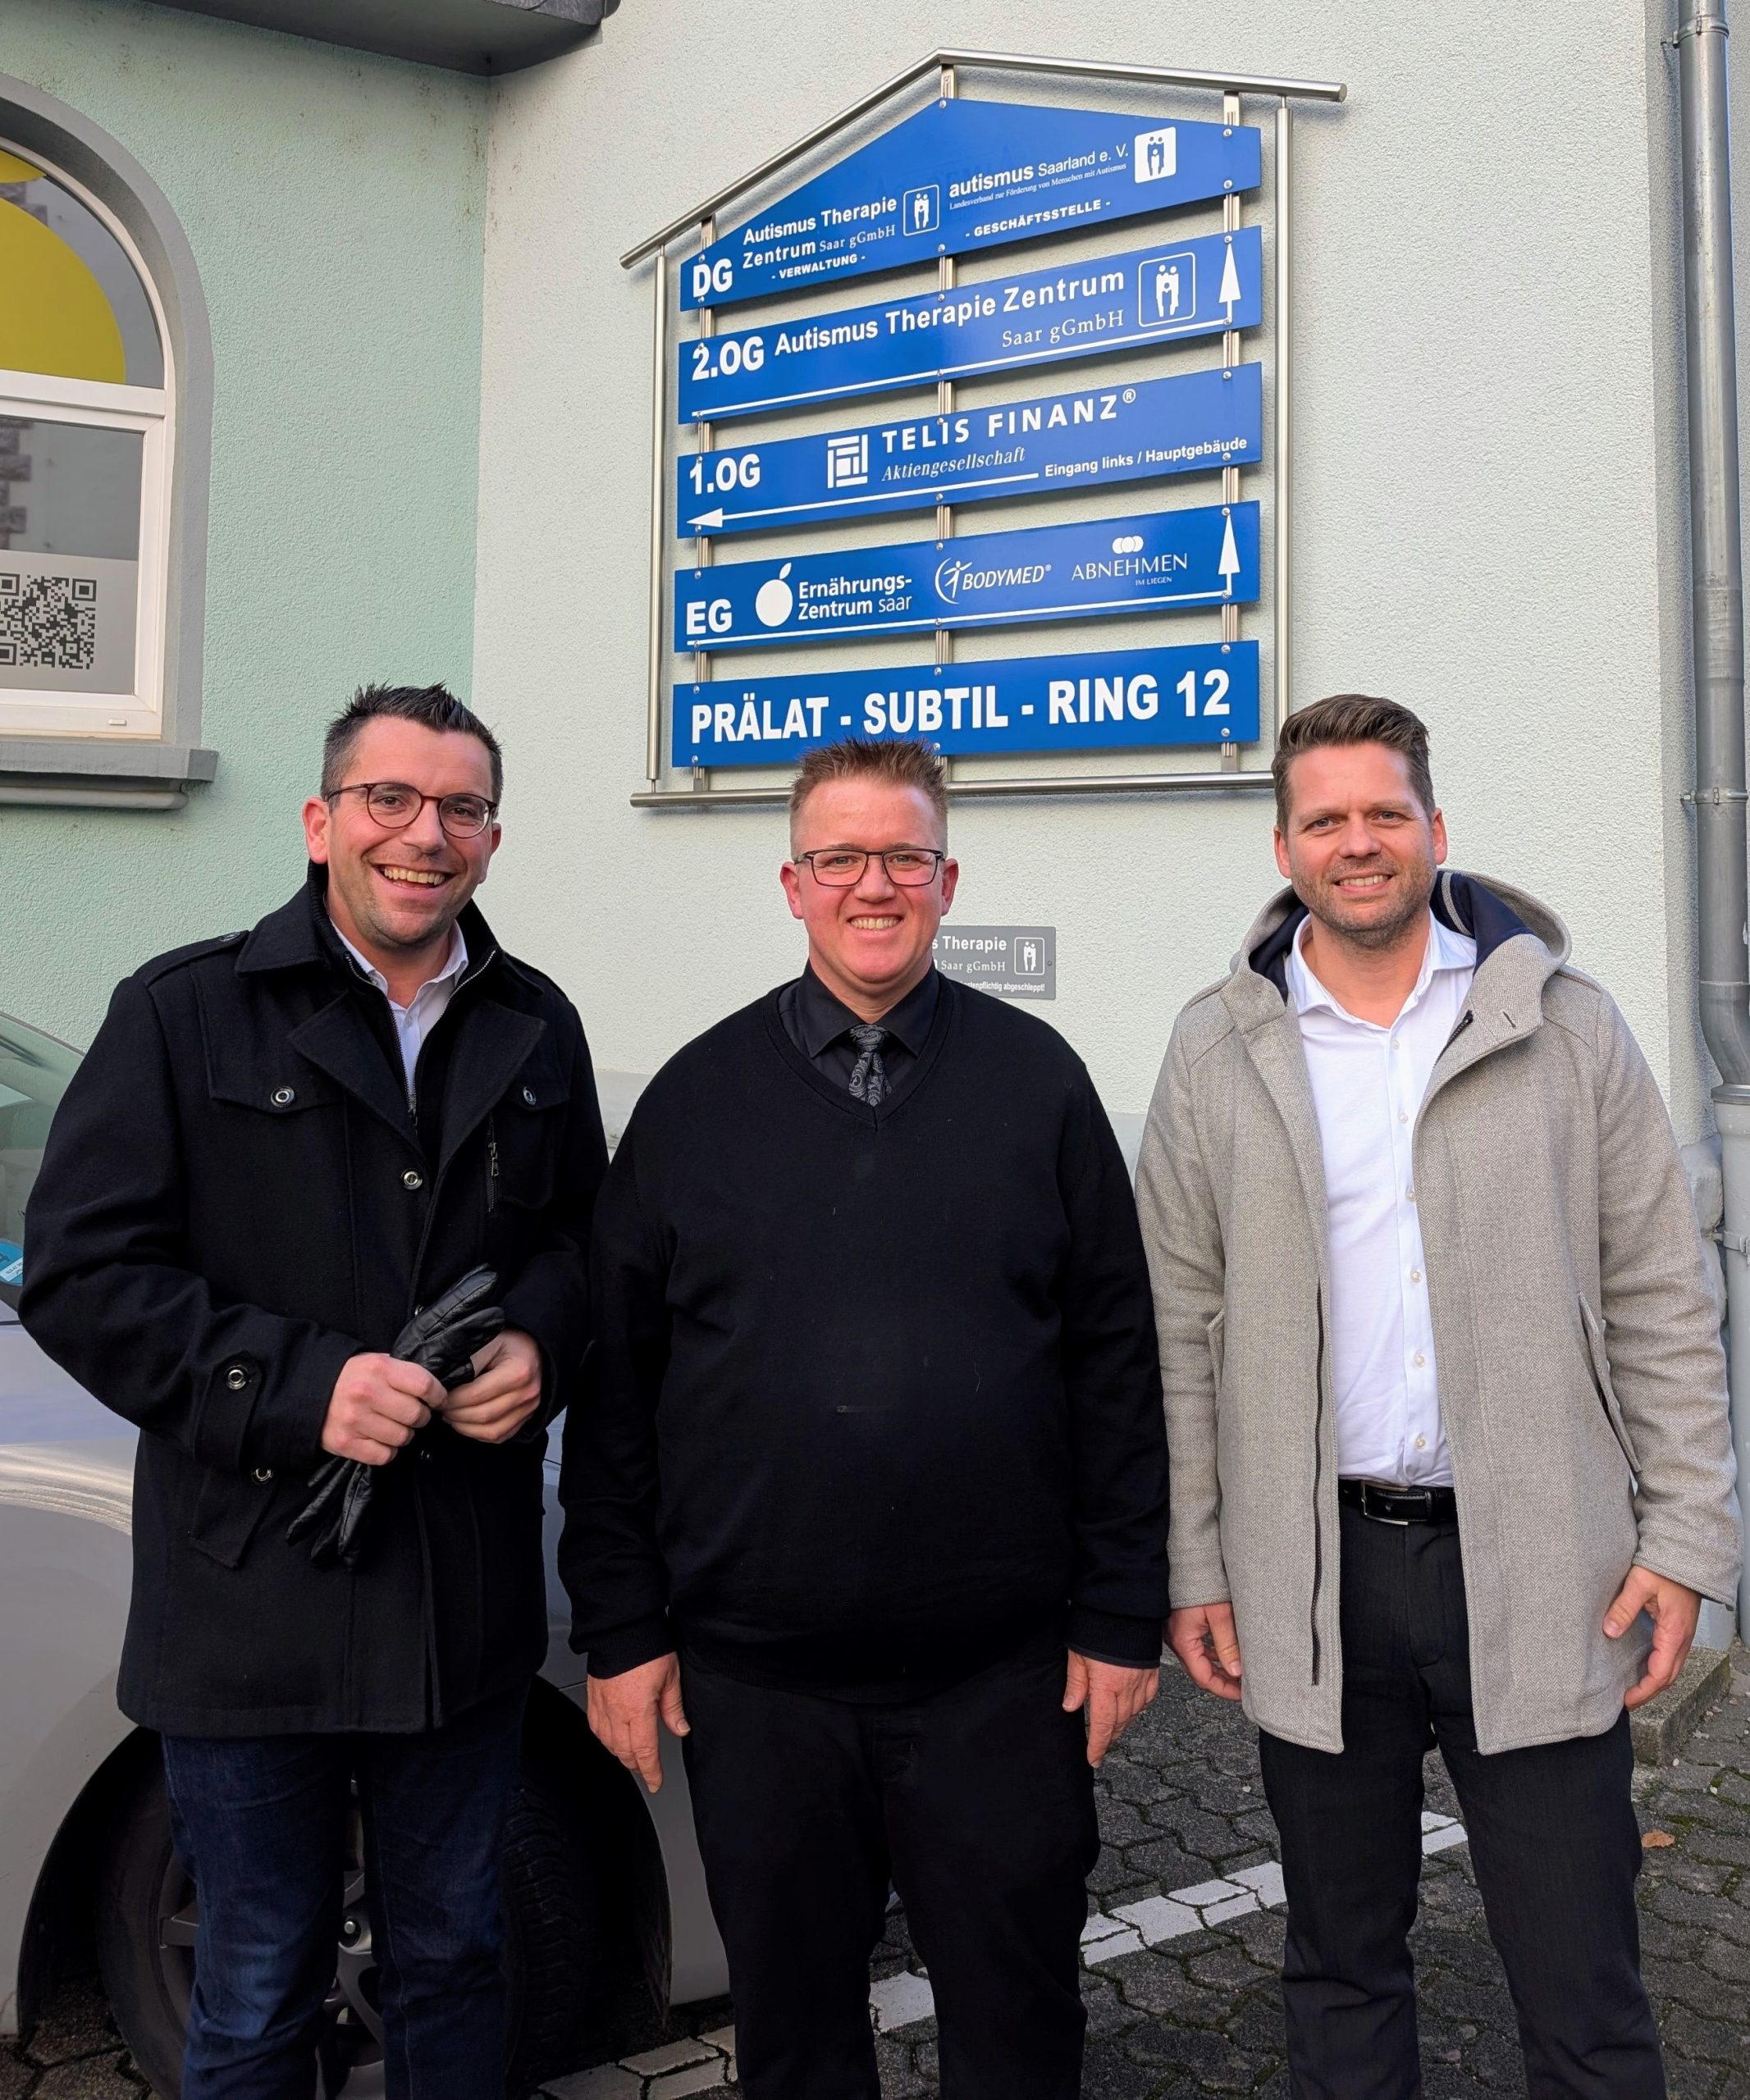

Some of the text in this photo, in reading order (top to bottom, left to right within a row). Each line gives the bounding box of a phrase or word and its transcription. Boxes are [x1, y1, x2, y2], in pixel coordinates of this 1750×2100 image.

[949, 166, 1034, 198] autismus
[1038, 151, 1096, 177] Saarland
[1099, 151, 1112, 163] e.
[1116, 144, 1129, 158] V.
[949, 193, 994, 210] Landesverband
[995, 191, 1004, 199] zur
[1006, 184, 1037, 197] Förderung
[1051, 173, 1083, 186] Menschen
[1084, 169, 1095, 179] mit
[1096, 163, 1127, 176] Autismus
[743, 197, 897, 245] Autismus Therapie
[974, 199, 1102, 237] GESCHÄFTSSTELLE
[742, 224, 896, 269] Zentrum Saar gGmbH
[693, 258, 733, 299] DG
[779, 253, 857, 279] VERWALTUNG
[774, 271, 1124, 356] Autismus Therapie Zentrum
[1002, 309, 1124, 348] Saar gGmbH
[692, 336, 765, 381] 2.OG
[881, 418, 970, 453] TELIS
[689, 453, 761, 495] 1.OG
[881, 445, 1026, 482] Aktiengesellschaft
[1044, 437, 1247, 477] Eingang links / Hauptgebäude
[1071, 552, 1188, 582] ABNEHMEN
[1135, 577, 1172, 587] IM LIEGEN
[798, 574, 912, 600] Ernährungs-
[686, 598, 733, 635] EG
[797, 595, 912, 621] Zentrum saar
[691, 692, 829, 744] PRÄLAT
[863, 683, 1008, 735] SUBTIL
[1049, 673, 1158, 725] RING
[1176, 669, 1231, 718] 12
[942, 936, 1008, 953] Therapie
[941, 960, 963, 970] Saar
[966, 961, 1006, 974] gGmbH
[1003, 982, 1045, 993] abgeschleppt!
